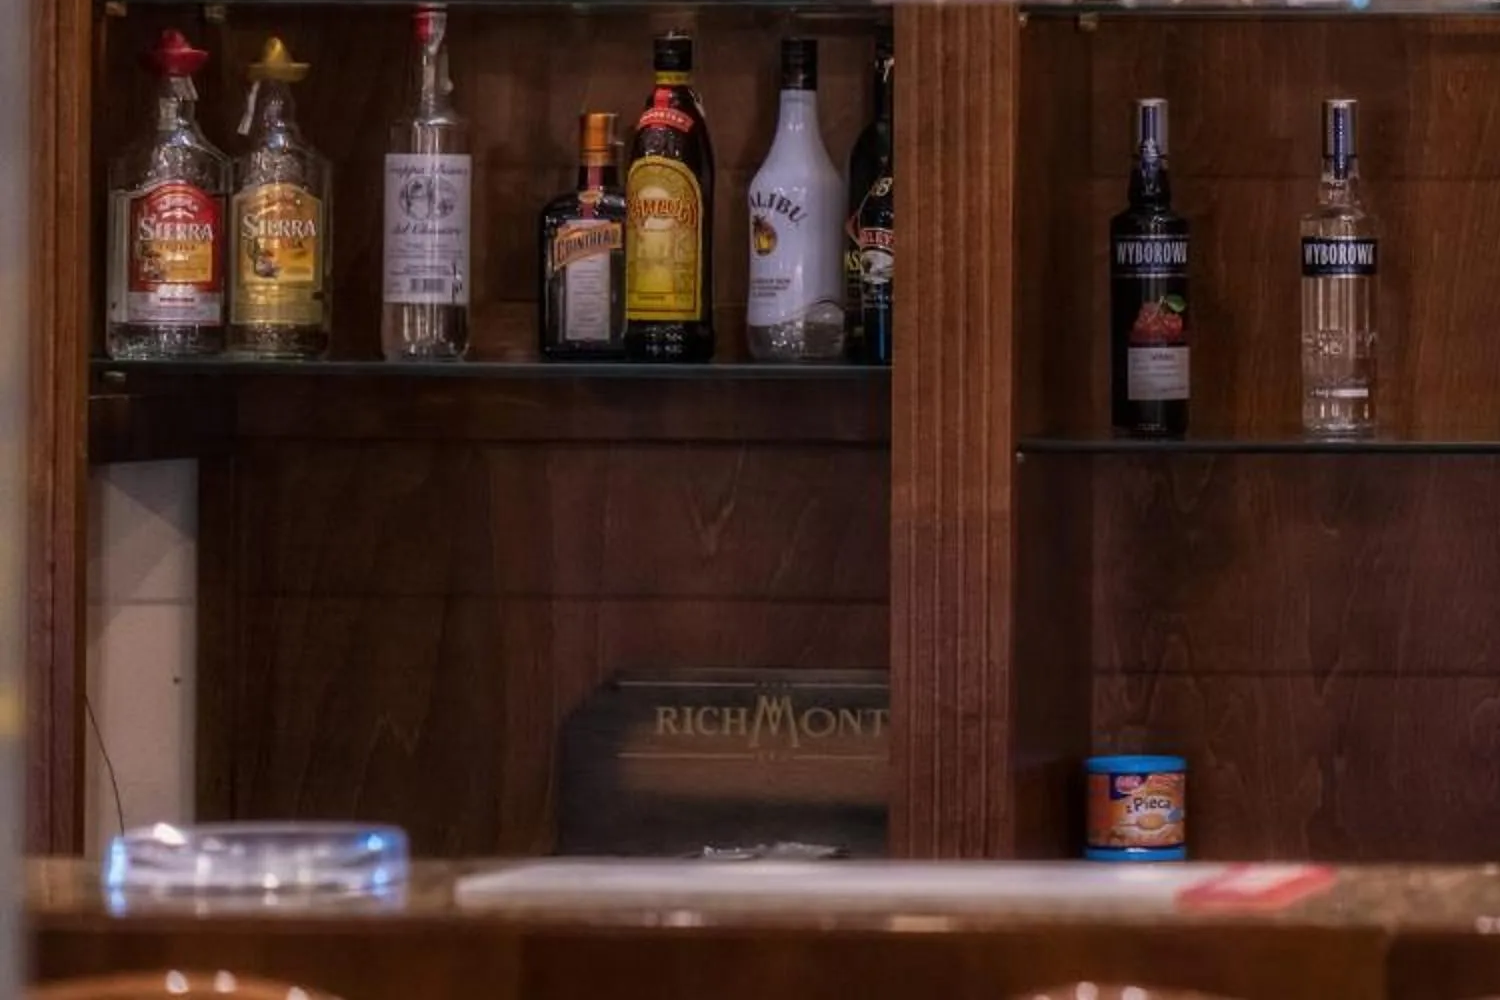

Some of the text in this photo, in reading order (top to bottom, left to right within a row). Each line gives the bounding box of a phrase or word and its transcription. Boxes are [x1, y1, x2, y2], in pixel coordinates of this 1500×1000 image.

[750, 191, 808, 222] ALIBU
[139, 214, 214, 241] SIERRA
[242, 212, 317, 238] SIERRA
